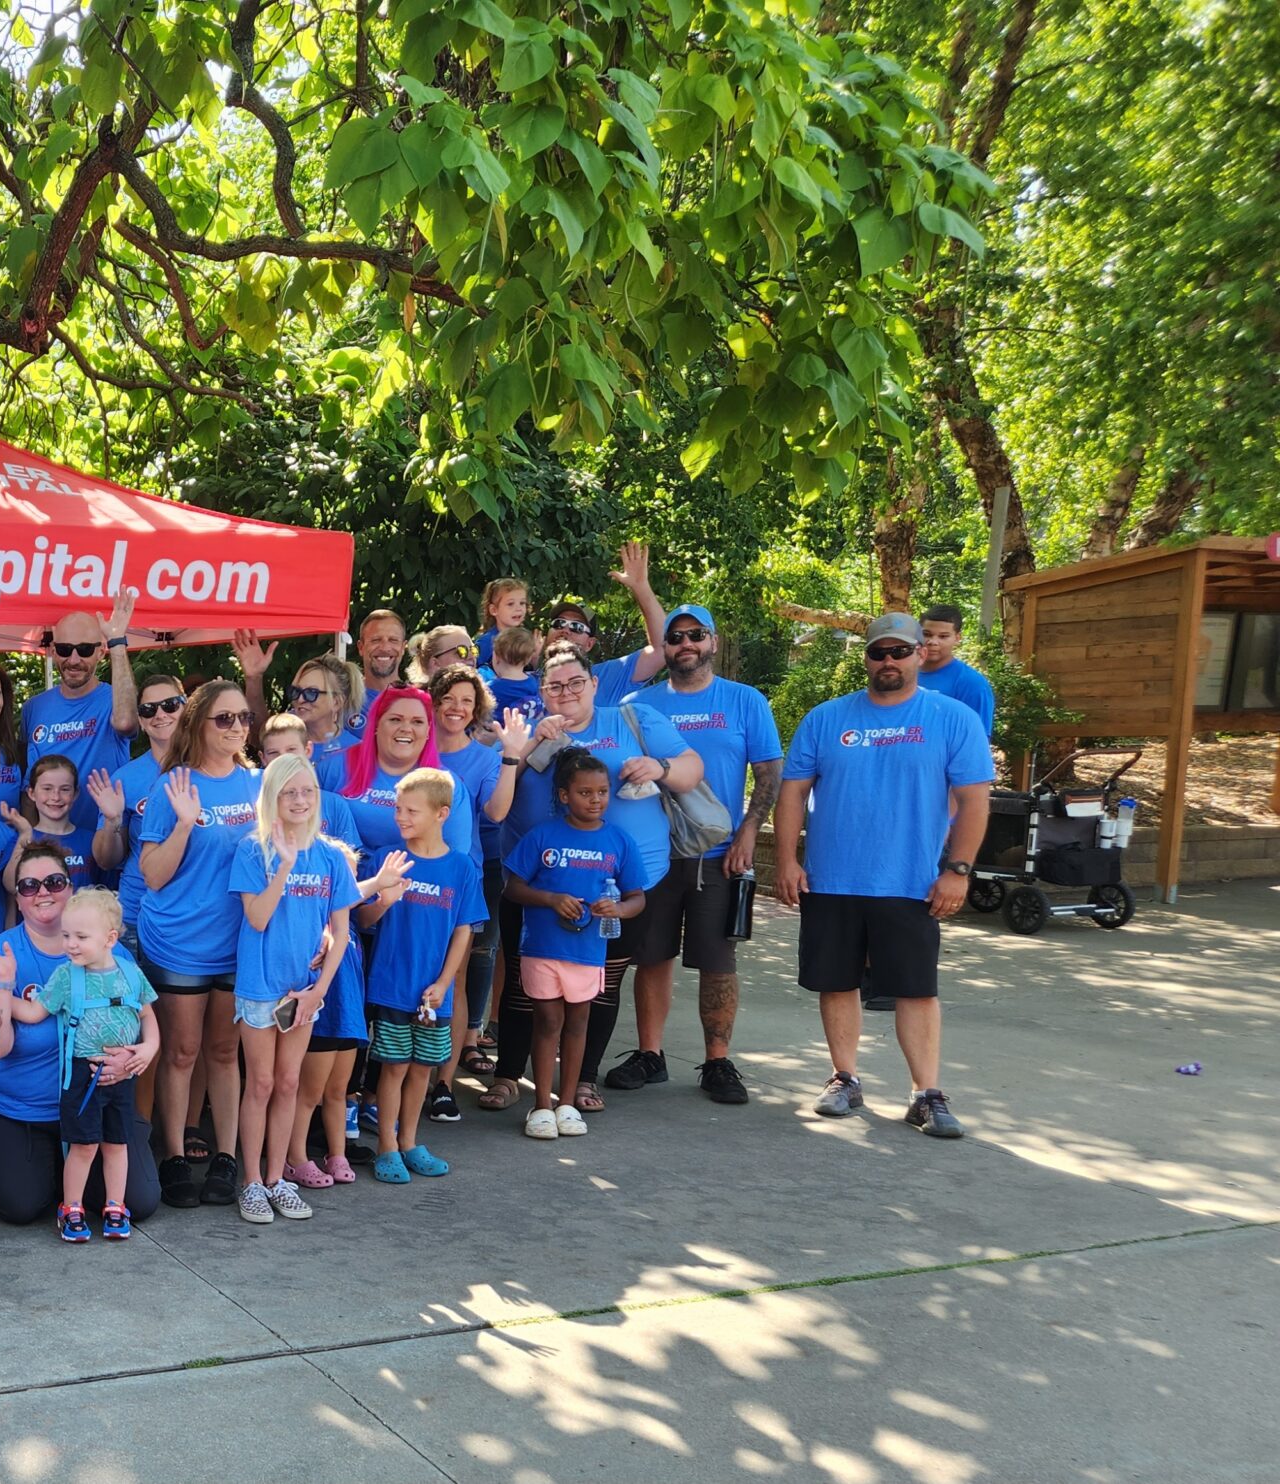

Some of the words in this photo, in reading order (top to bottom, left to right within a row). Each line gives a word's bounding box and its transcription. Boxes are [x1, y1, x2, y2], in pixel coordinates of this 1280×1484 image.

[3, 463, 55, 481] ER
[671, 713, 710, 724] TOPEKA
[711, 712, 725, 721] ER
[50, 720, 84, 733] TOPEKA
[677, 720, 728, 731] HOSPITAL
[864, 726, 906, 738] TOPEKA
[907, 725, 922, 735] ER
[862, 737, 870, 747] &
[872, 734, 925, 747] HOSPITAL
[365, 787, 397, 801] TOPEK
[211, 802, 253, 816] TOPEKA
[224, 811, 257, 827] HOSPI
[561, 847, 603, 861] TOPEKA
[559, 857, 568, 868] &
[286, 873, 321, 886] OPEKA
[404, 878, 441, 897] OPEKA
